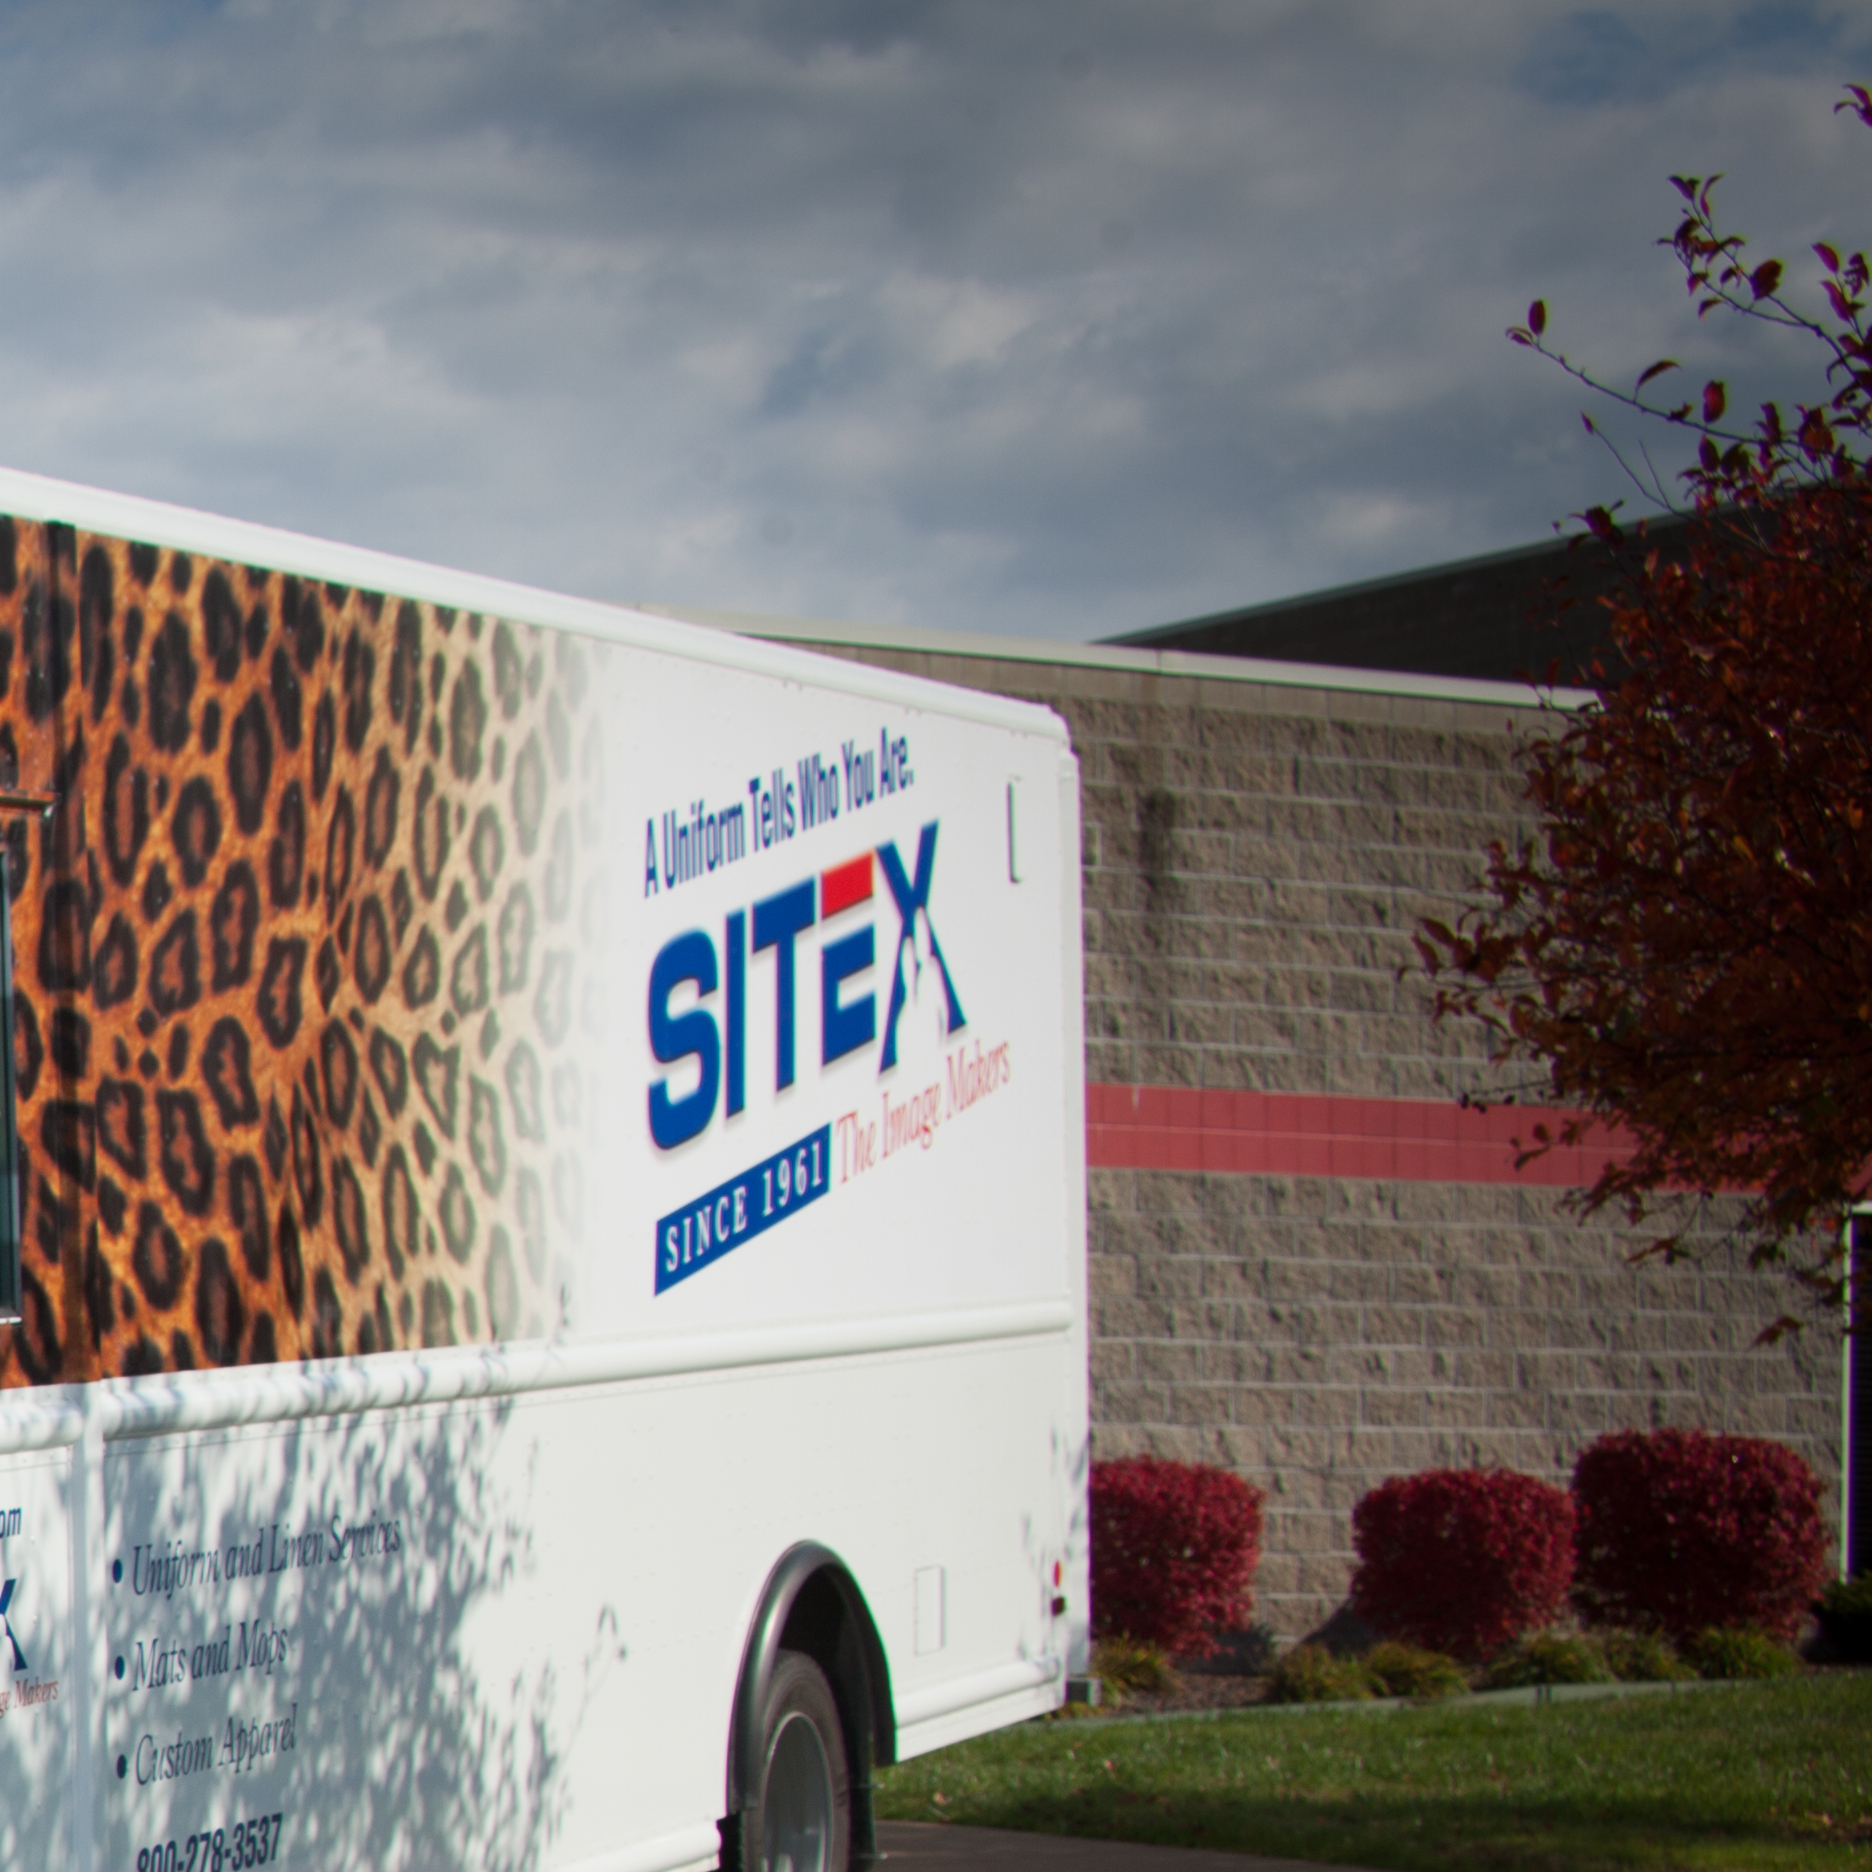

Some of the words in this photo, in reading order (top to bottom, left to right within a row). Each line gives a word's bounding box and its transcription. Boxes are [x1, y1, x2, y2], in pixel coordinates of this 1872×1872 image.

[644, 817, 659, 899] A
[663, 798, 746, 890] Uniform
[748, 766, 796, 853] Tells
[798, 752, 839, 832] Who
[841, 738, 875, 814] You
[879, 726, 914, 800] Are.
[647, 817, 967, 1151] SITEX
[835, 1109, 876, 1185] The
[881, 1083, 941, 1160] Image
[946, 1037, 1010, 1121] Makers
[665, 1186, 748, 1274] SINCE
[762, 1140, 824, 1219] 1961
[132, 1539, 220, 1600] Uniform
[225, 1527, 264, 1580] and
[269, 1523, 324, 1573] Linen
[328, 1509, 401, 1563] Services
[13, 1676, 59, 1709] Makers
[132, 1638, 186, 1692] Mats
[191, 1624, 232, 1680] and
[236, 1619, 288, 1676] Mops
[136, 1732, 214, 1786] Custom
[217, 1702, 299, 1775] Apparel
